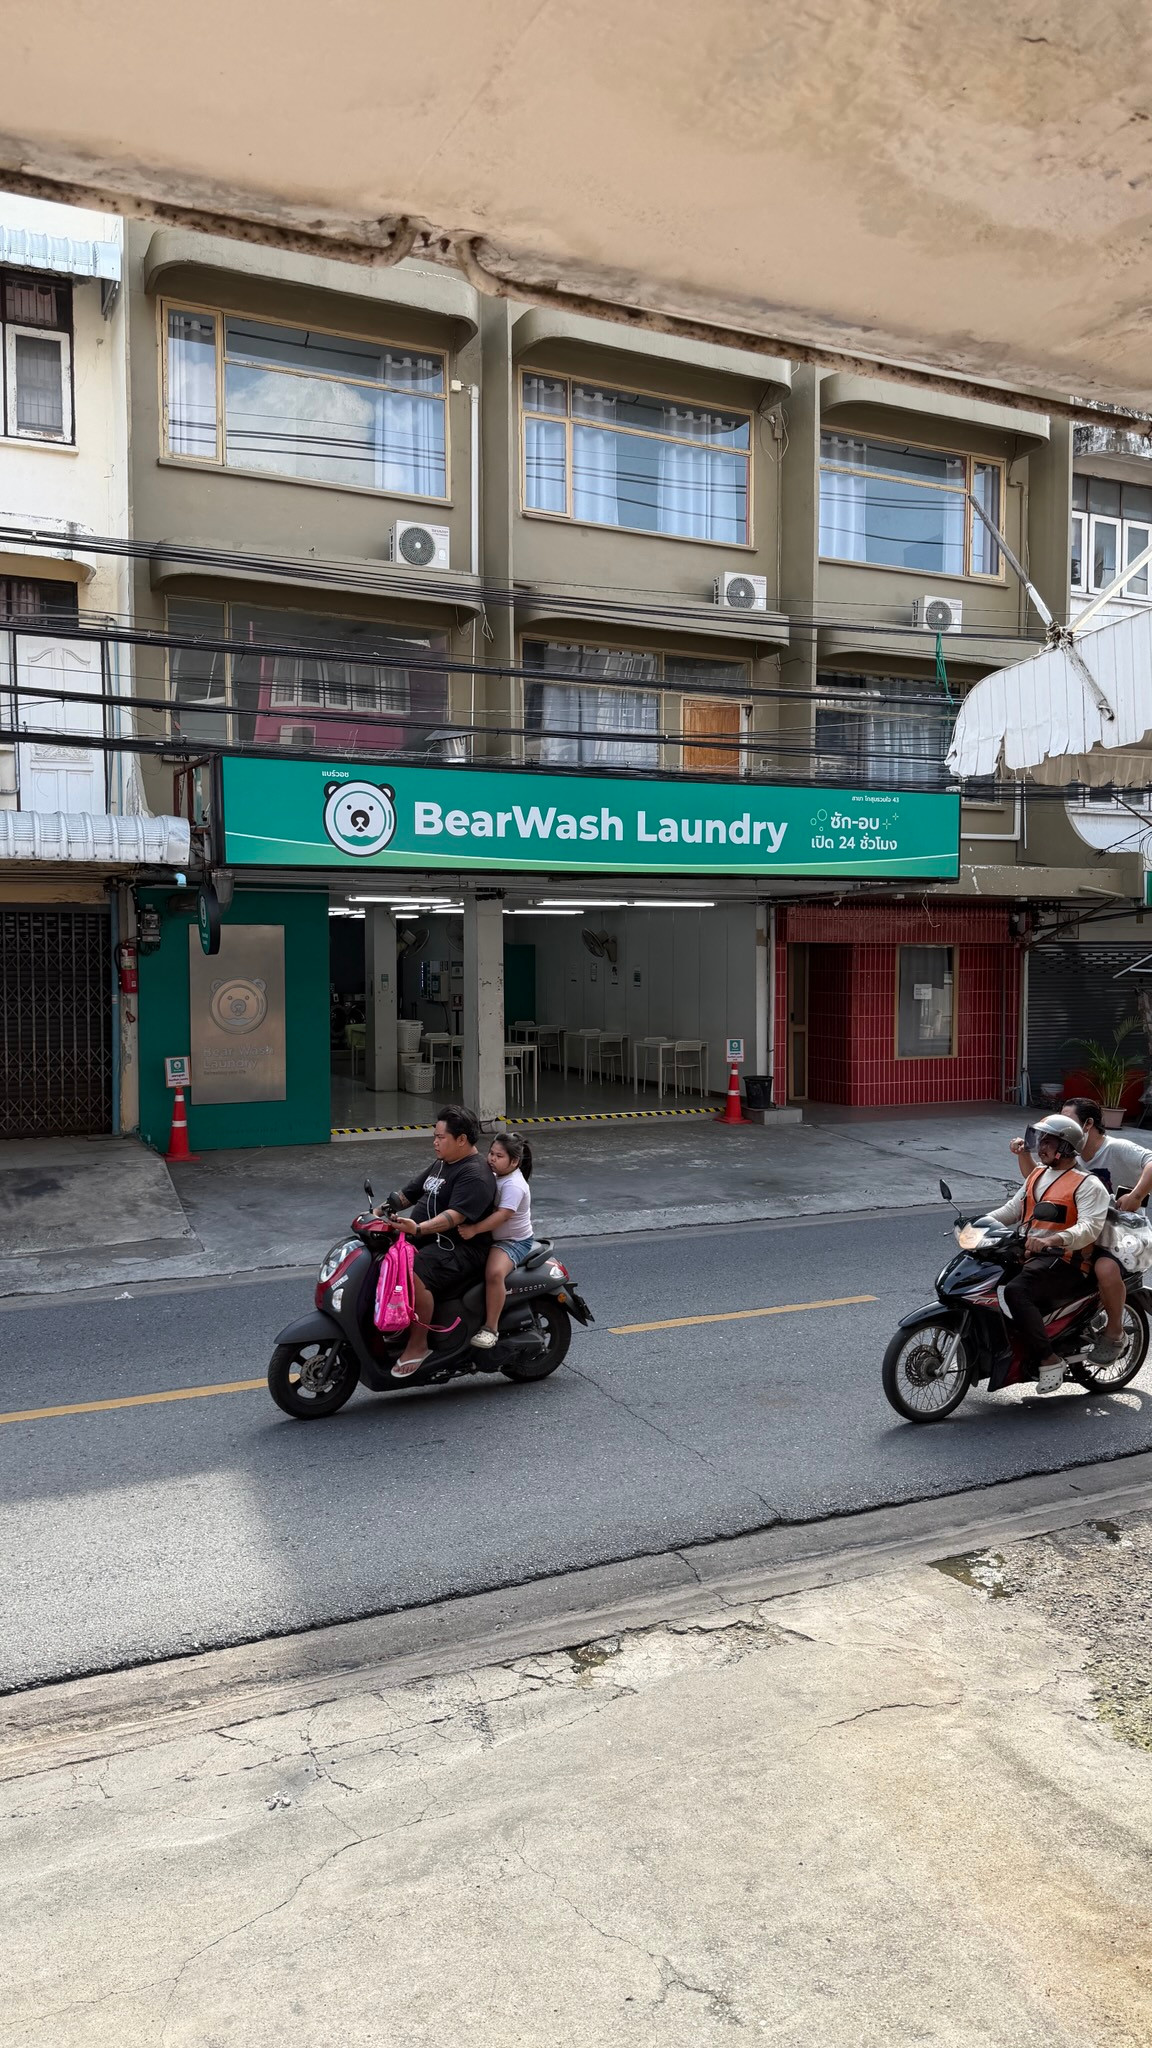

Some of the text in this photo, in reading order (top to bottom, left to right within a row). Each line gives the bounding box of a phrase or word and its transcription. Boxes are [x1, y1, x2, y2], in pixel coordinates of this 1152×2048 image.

[321, 769, 350, 778] แบร์วอช
[830, 811, 880, 830] ซัก-อบ
[414, 801, 789, 854] BearWash Laundry
[811, 832, 898, 851] เปิด 24 ชั่วโมง
[203, 1045, 275, 1057] Bear Wash
[203, 1057, 258, 1070] Laundry
[519, 1283, 547, 1293] SCOOPY
